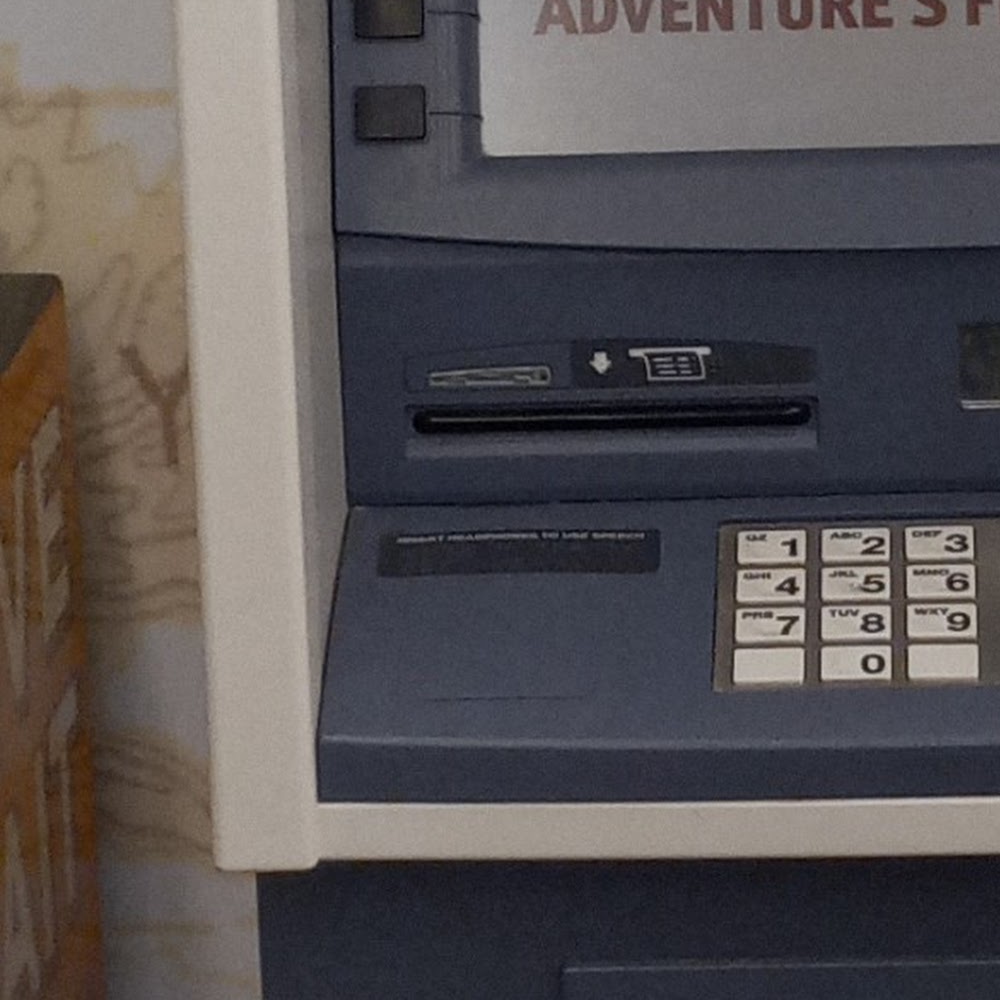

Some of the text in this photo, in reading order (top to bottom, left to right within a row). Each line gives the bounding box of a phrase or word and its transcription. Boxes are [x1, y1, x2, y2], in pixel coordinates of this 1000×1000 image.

[780, 538, 798, 557] 1
[860, 536, 886, 556] 2
[944, 533, 969, 553] 3
[774, 576, 800, 596] 4
[860, 574, 885, 593] 5
[946, 573, 970, 592] 6
[776, 615, 799, 636] 7
[829, 609, 885, 633] TUV 8
[914, 607, 971, 632] WXY 9
[861, 655, 885, 674] 0
